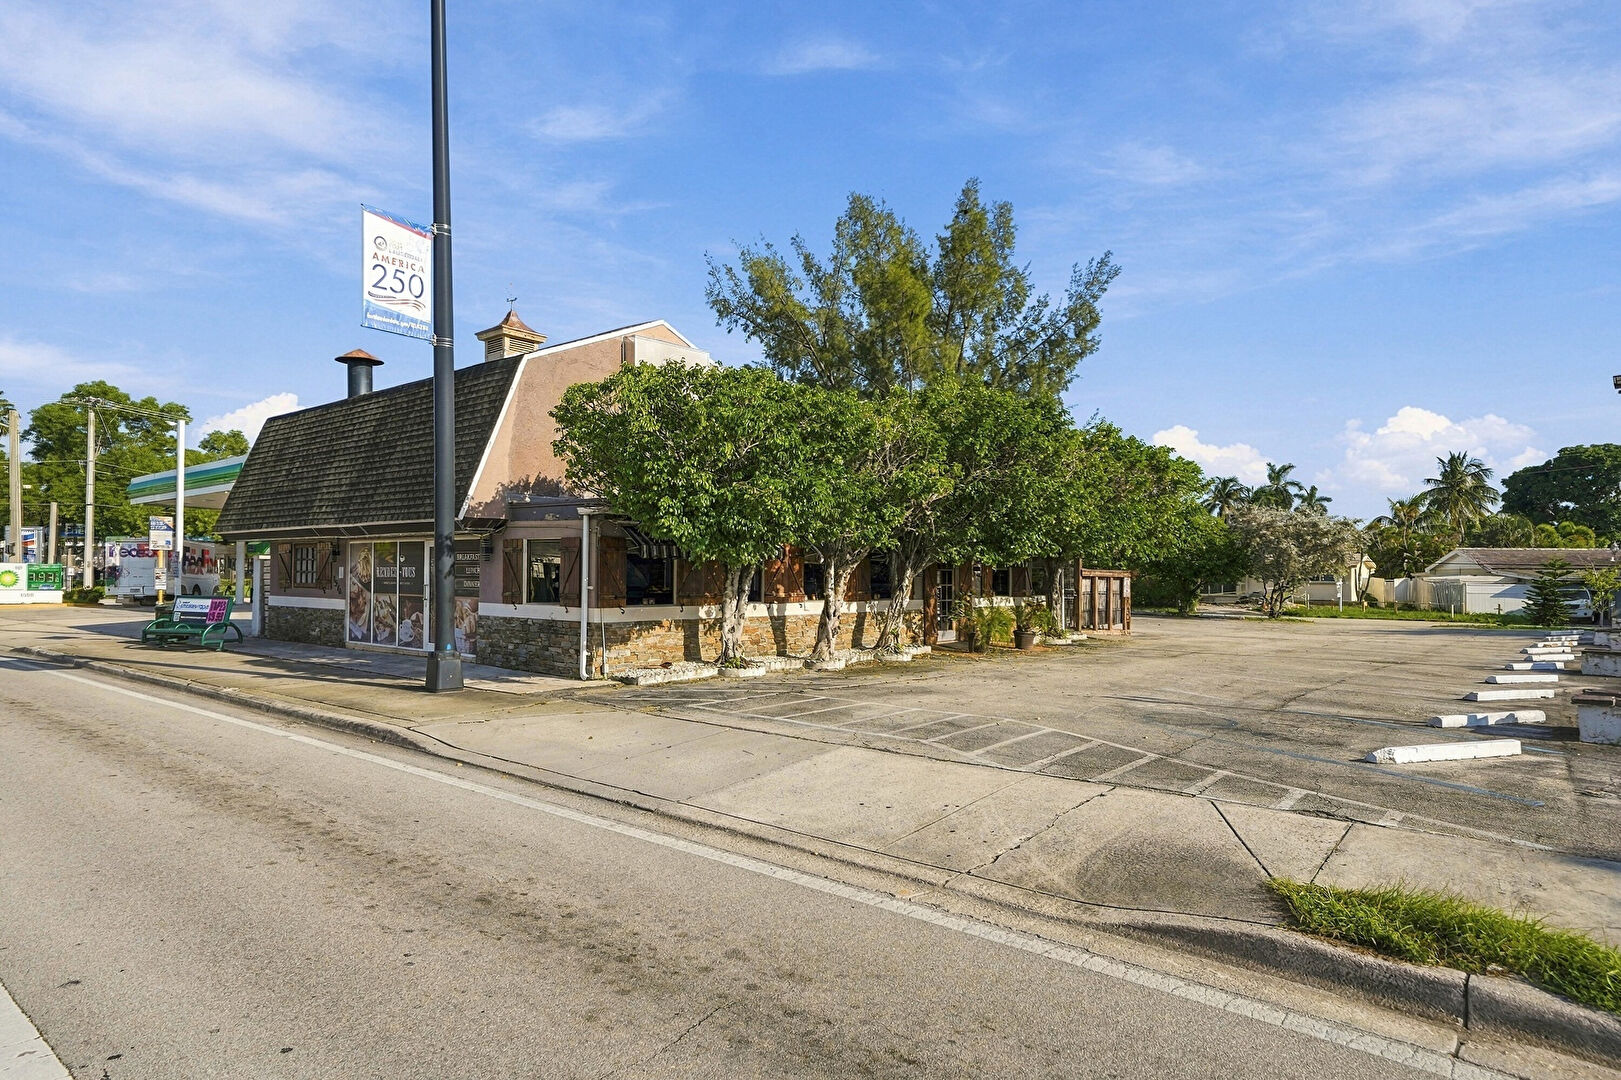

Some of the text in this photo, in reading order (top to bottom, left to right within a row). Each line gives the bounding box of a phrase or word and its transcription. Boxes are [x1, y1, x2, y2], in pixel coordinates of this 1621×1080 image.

[372, 252, 425, 273] AMERICA
[372, 263, 424, 299] 250
[456, 553, 480, 561] BREAKFAST
